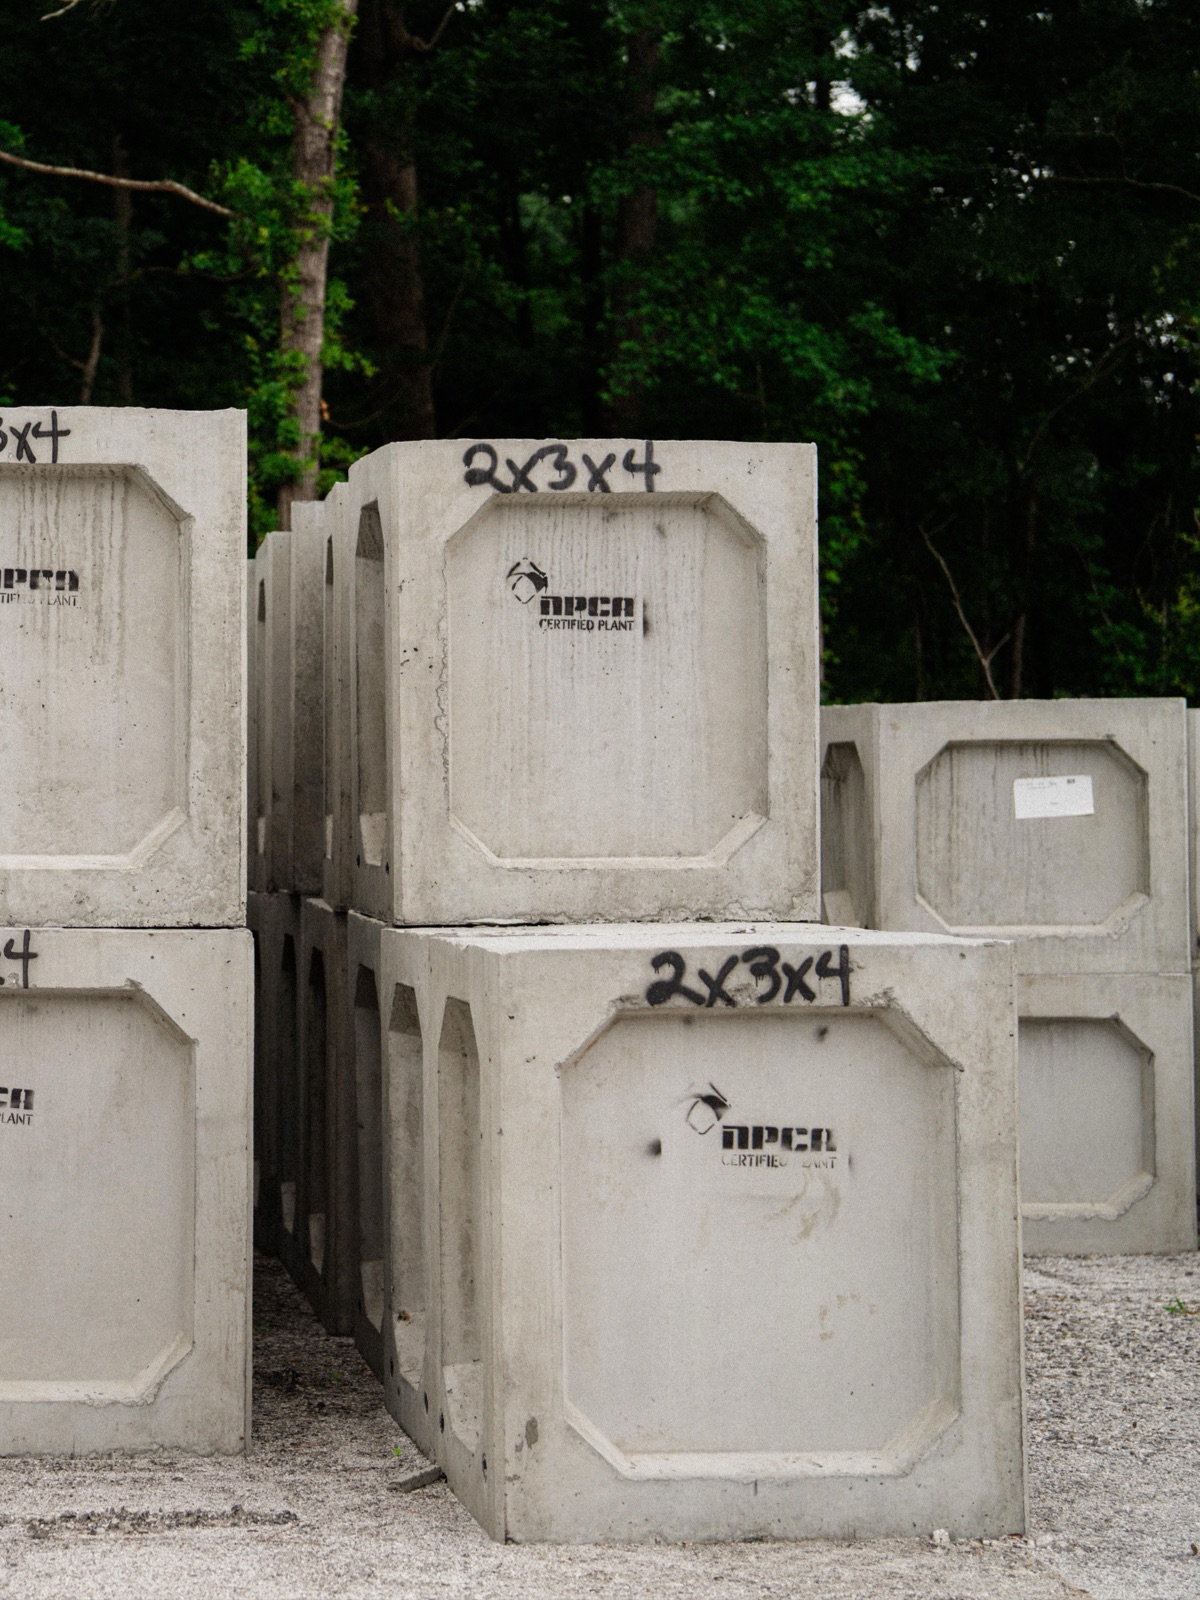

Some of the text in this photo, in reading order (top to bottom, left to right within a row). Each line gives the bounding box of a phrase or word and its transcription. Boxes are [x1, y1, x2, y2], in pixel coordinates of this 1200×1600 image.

[39, 594, 79, 607] LANT
[538, 618, 635, 632] CERTIFIED PLANT
